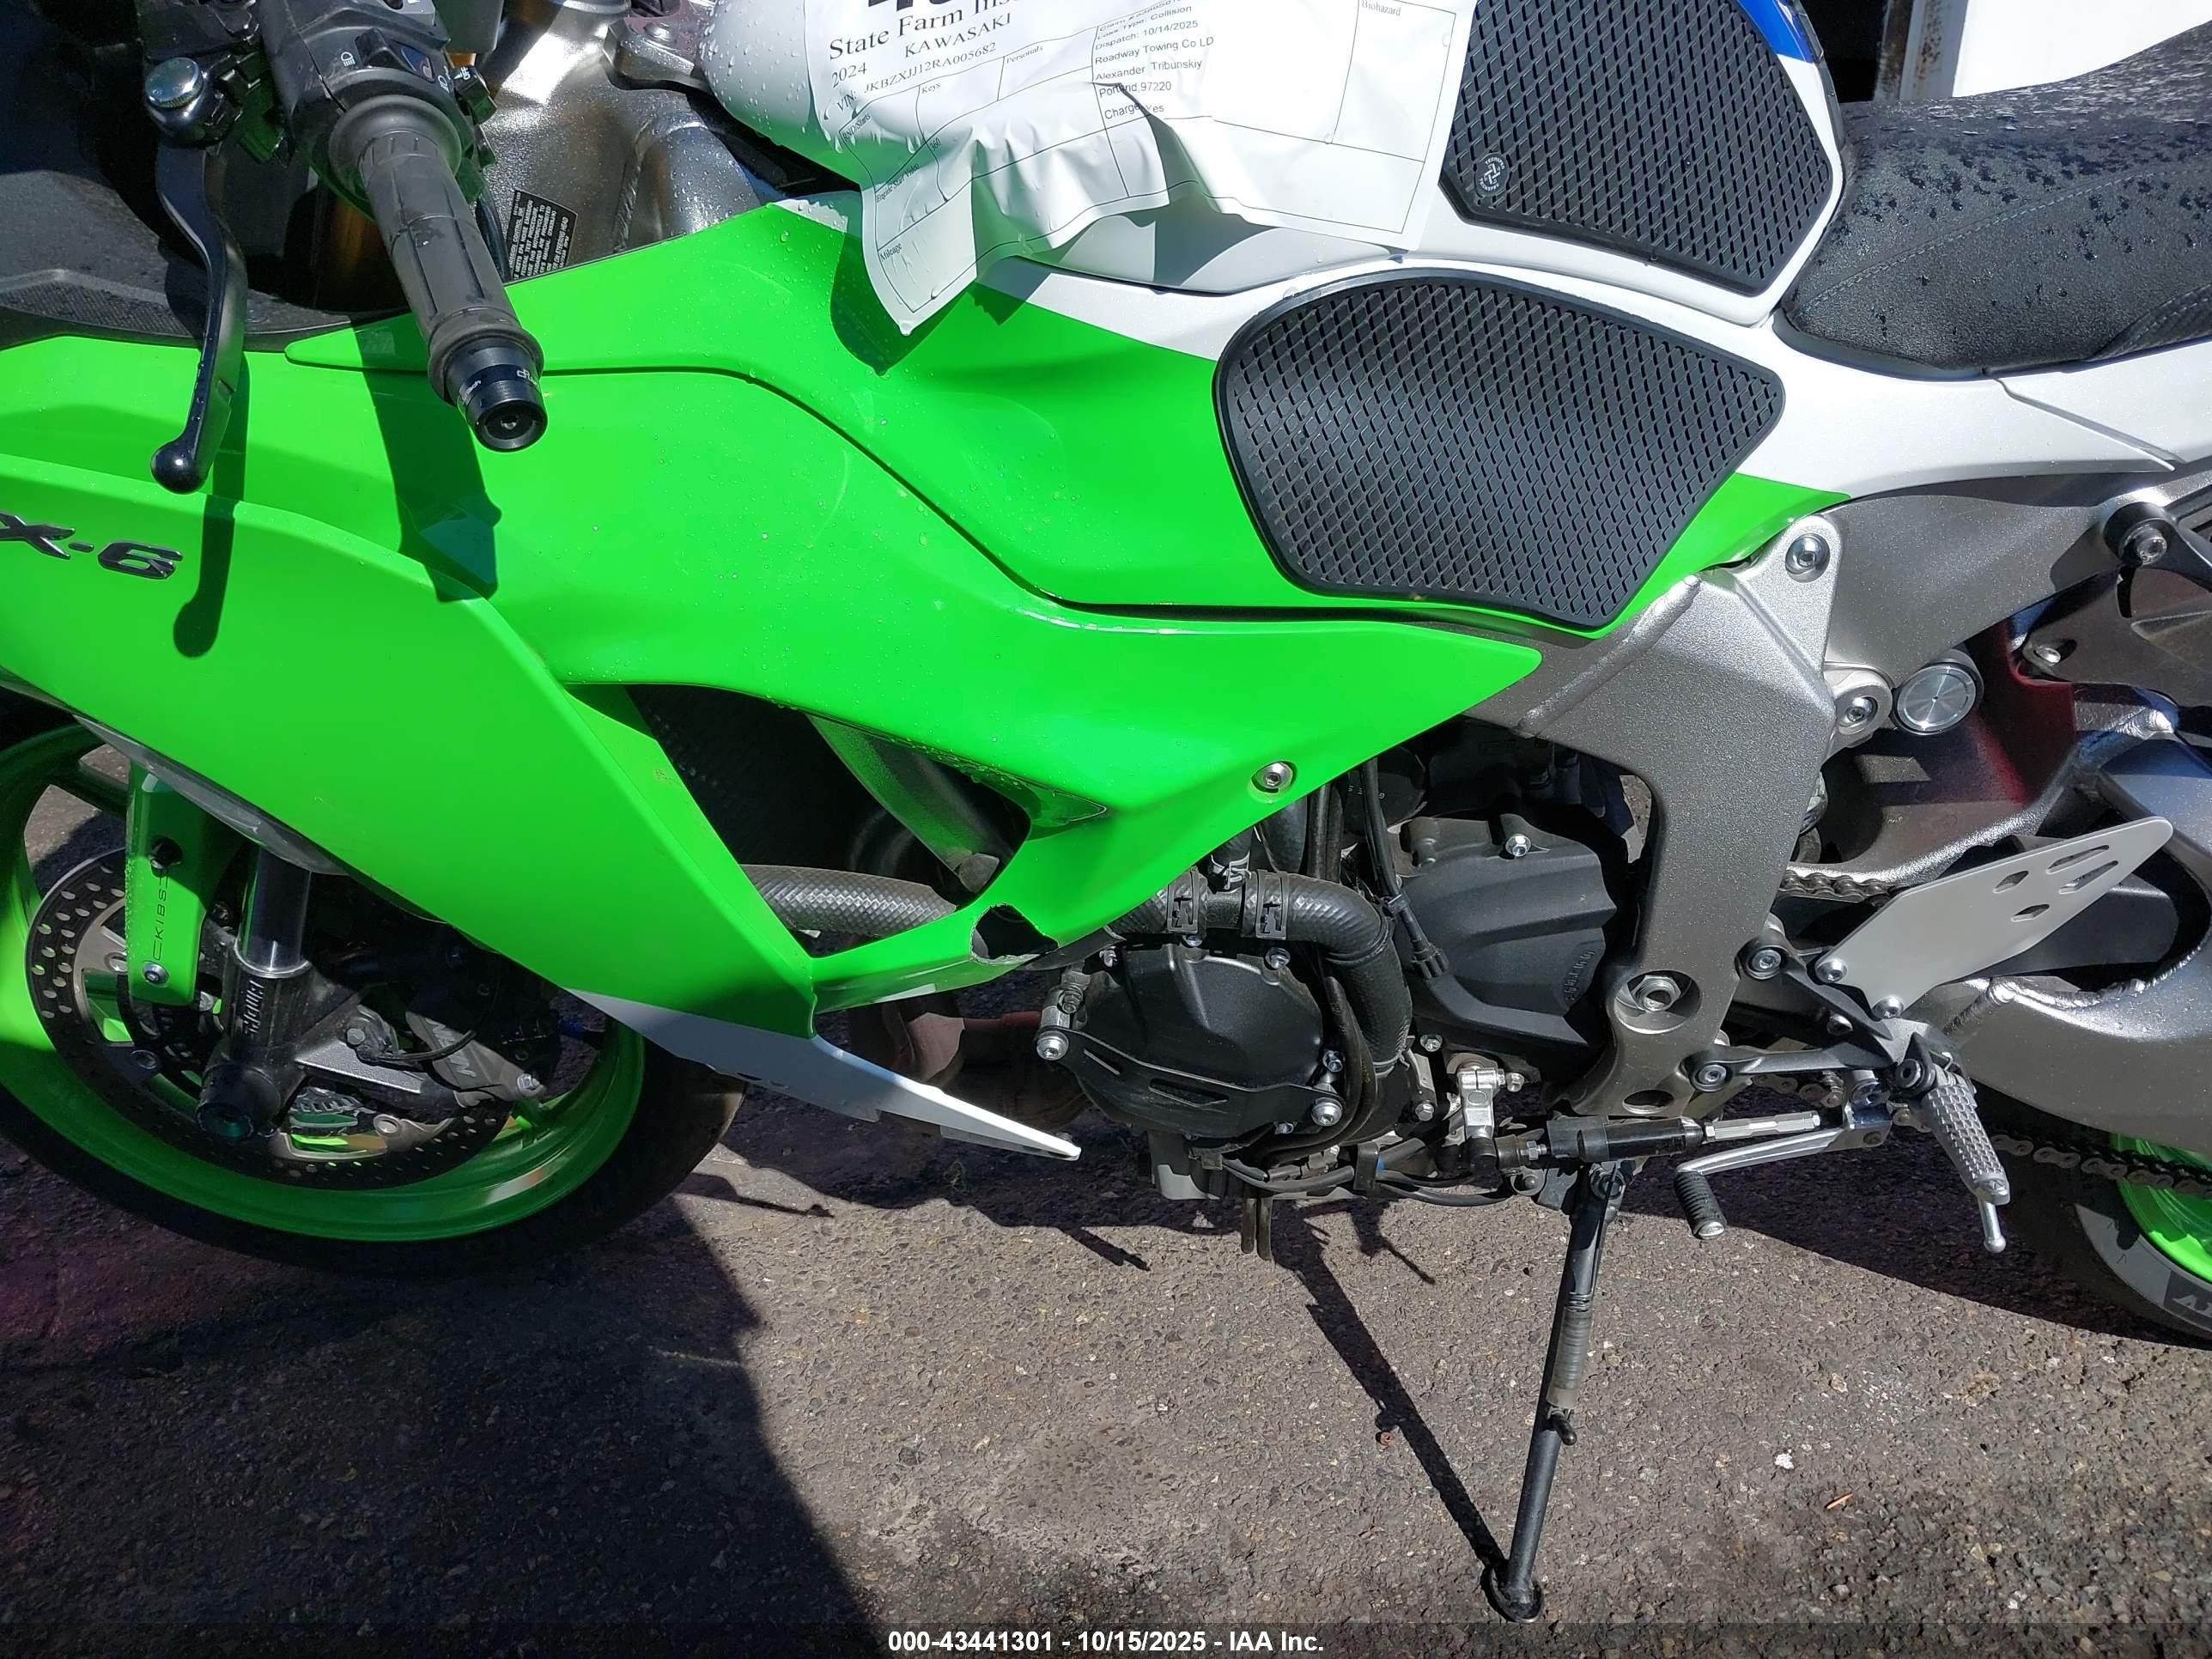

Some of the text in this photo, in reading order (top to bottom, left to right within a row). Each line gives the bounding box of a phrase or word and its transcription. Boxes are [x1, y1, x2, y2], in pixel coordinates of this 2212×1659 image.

[1150, 5, 1192, 21] Collision
[1361, 0, 1401, 16] Biohazard
[830, 30, 889, 61] State
[897, 9, 963, 39] Farm
[904, 12, 1012, 58] KAWASAKI
[1095, 20, 1199, 50] Dispatch: 10/14/2025
[1006, 46, 1043, 64] Personals
[1095, 36, 1214, 65] Roadway Towing Co LD
[830, 62, 867, 88] 2024
[835, 42, 997, 112] VIN: JKBZXJJ12RA005682
[1095, 59, 1203, 82] Alexander Tribunskiy
[921, 82, 942, 94] Keys
[929, 137, 941, 152] 360
[525, 200, 533, 224] EMISSION
[541, 206, 551, 236] PROHIBITED
[513, 219, 521, 242] CONTROL
[532, 215, 544, 248] MOTORCYCLE
[556, 231, 566, 255] STEERING
[879, 242, 902, 261] Mileage
[520, 255, 529, 276] FEDERAL
